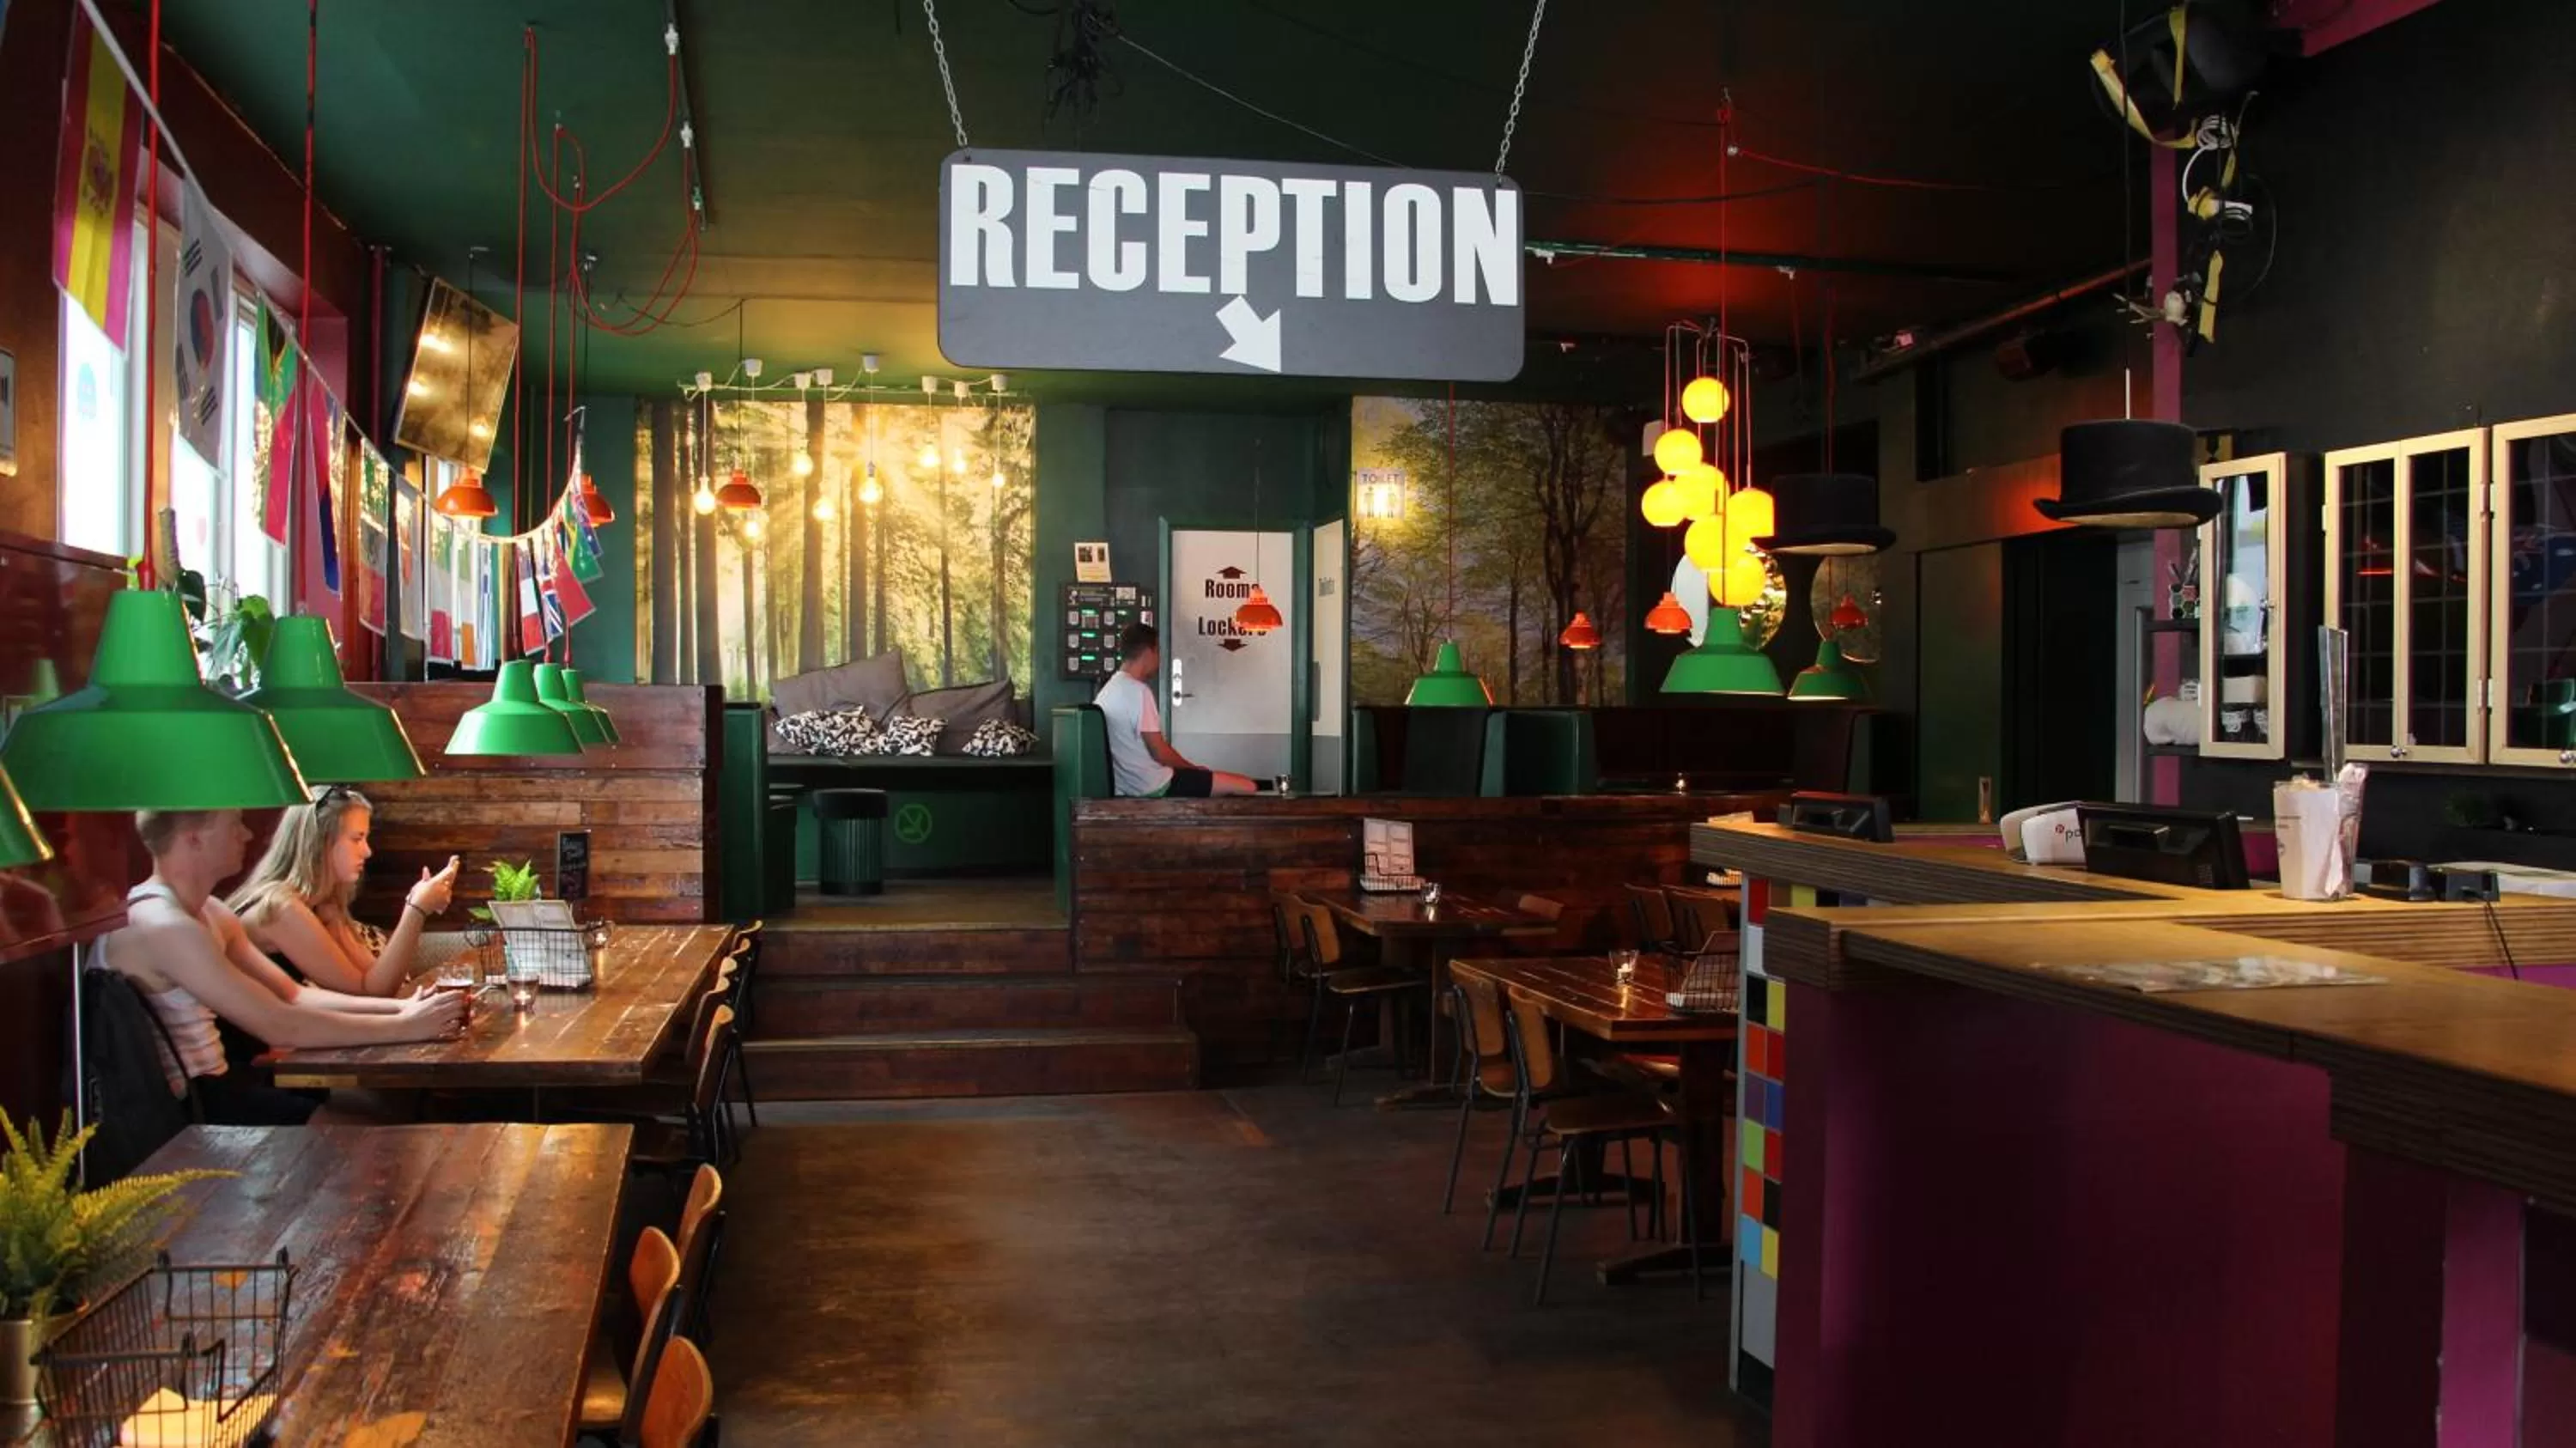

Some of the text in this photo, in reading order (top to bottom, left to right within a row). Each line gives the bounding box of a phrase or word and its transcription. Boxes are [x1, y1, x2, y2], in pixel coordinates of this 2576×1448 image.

[950, 163, 1518, 306] RECEPTION
[1361, 473, 1400, 484] TOET
[1198, 617, 1267, 636] Lock
